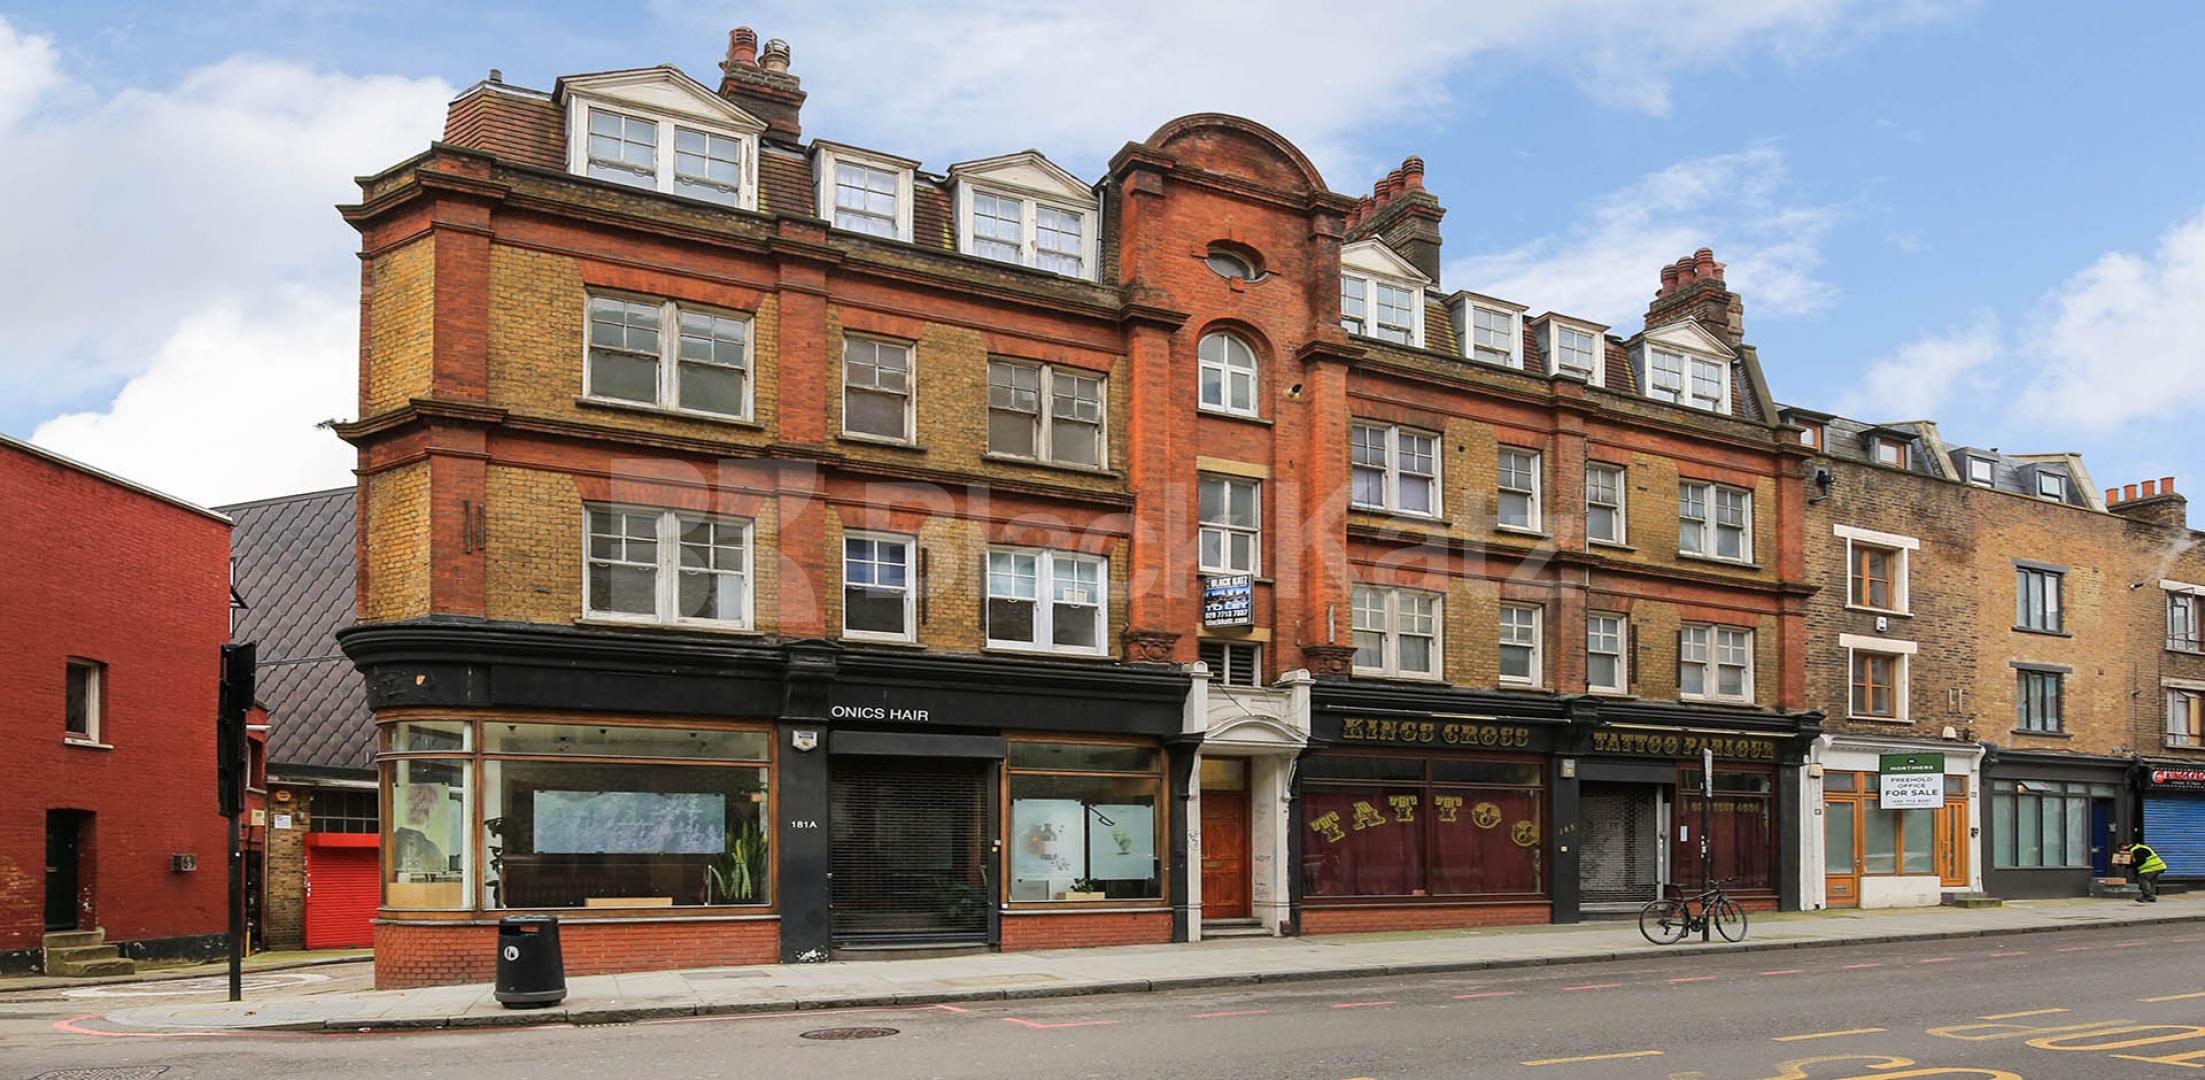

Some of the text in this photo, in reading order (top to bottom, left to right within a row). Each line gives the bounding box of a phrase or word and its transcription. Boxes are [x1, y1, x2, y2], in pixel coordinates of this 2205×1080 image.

[1206, 601, 1249, 611] TO LET
[831, 705, 929, 721] ONICS HAIR
[1343, 717, 1529, 748] KINGS CROSS
[1593, 732, 1776, 759] TATTOO PARLOUR
[1885, 788, 1939, 797] FOR SALE
[791, 820, 818, 829] 181A
[1309, 795, 1539, 847] TATTOO
